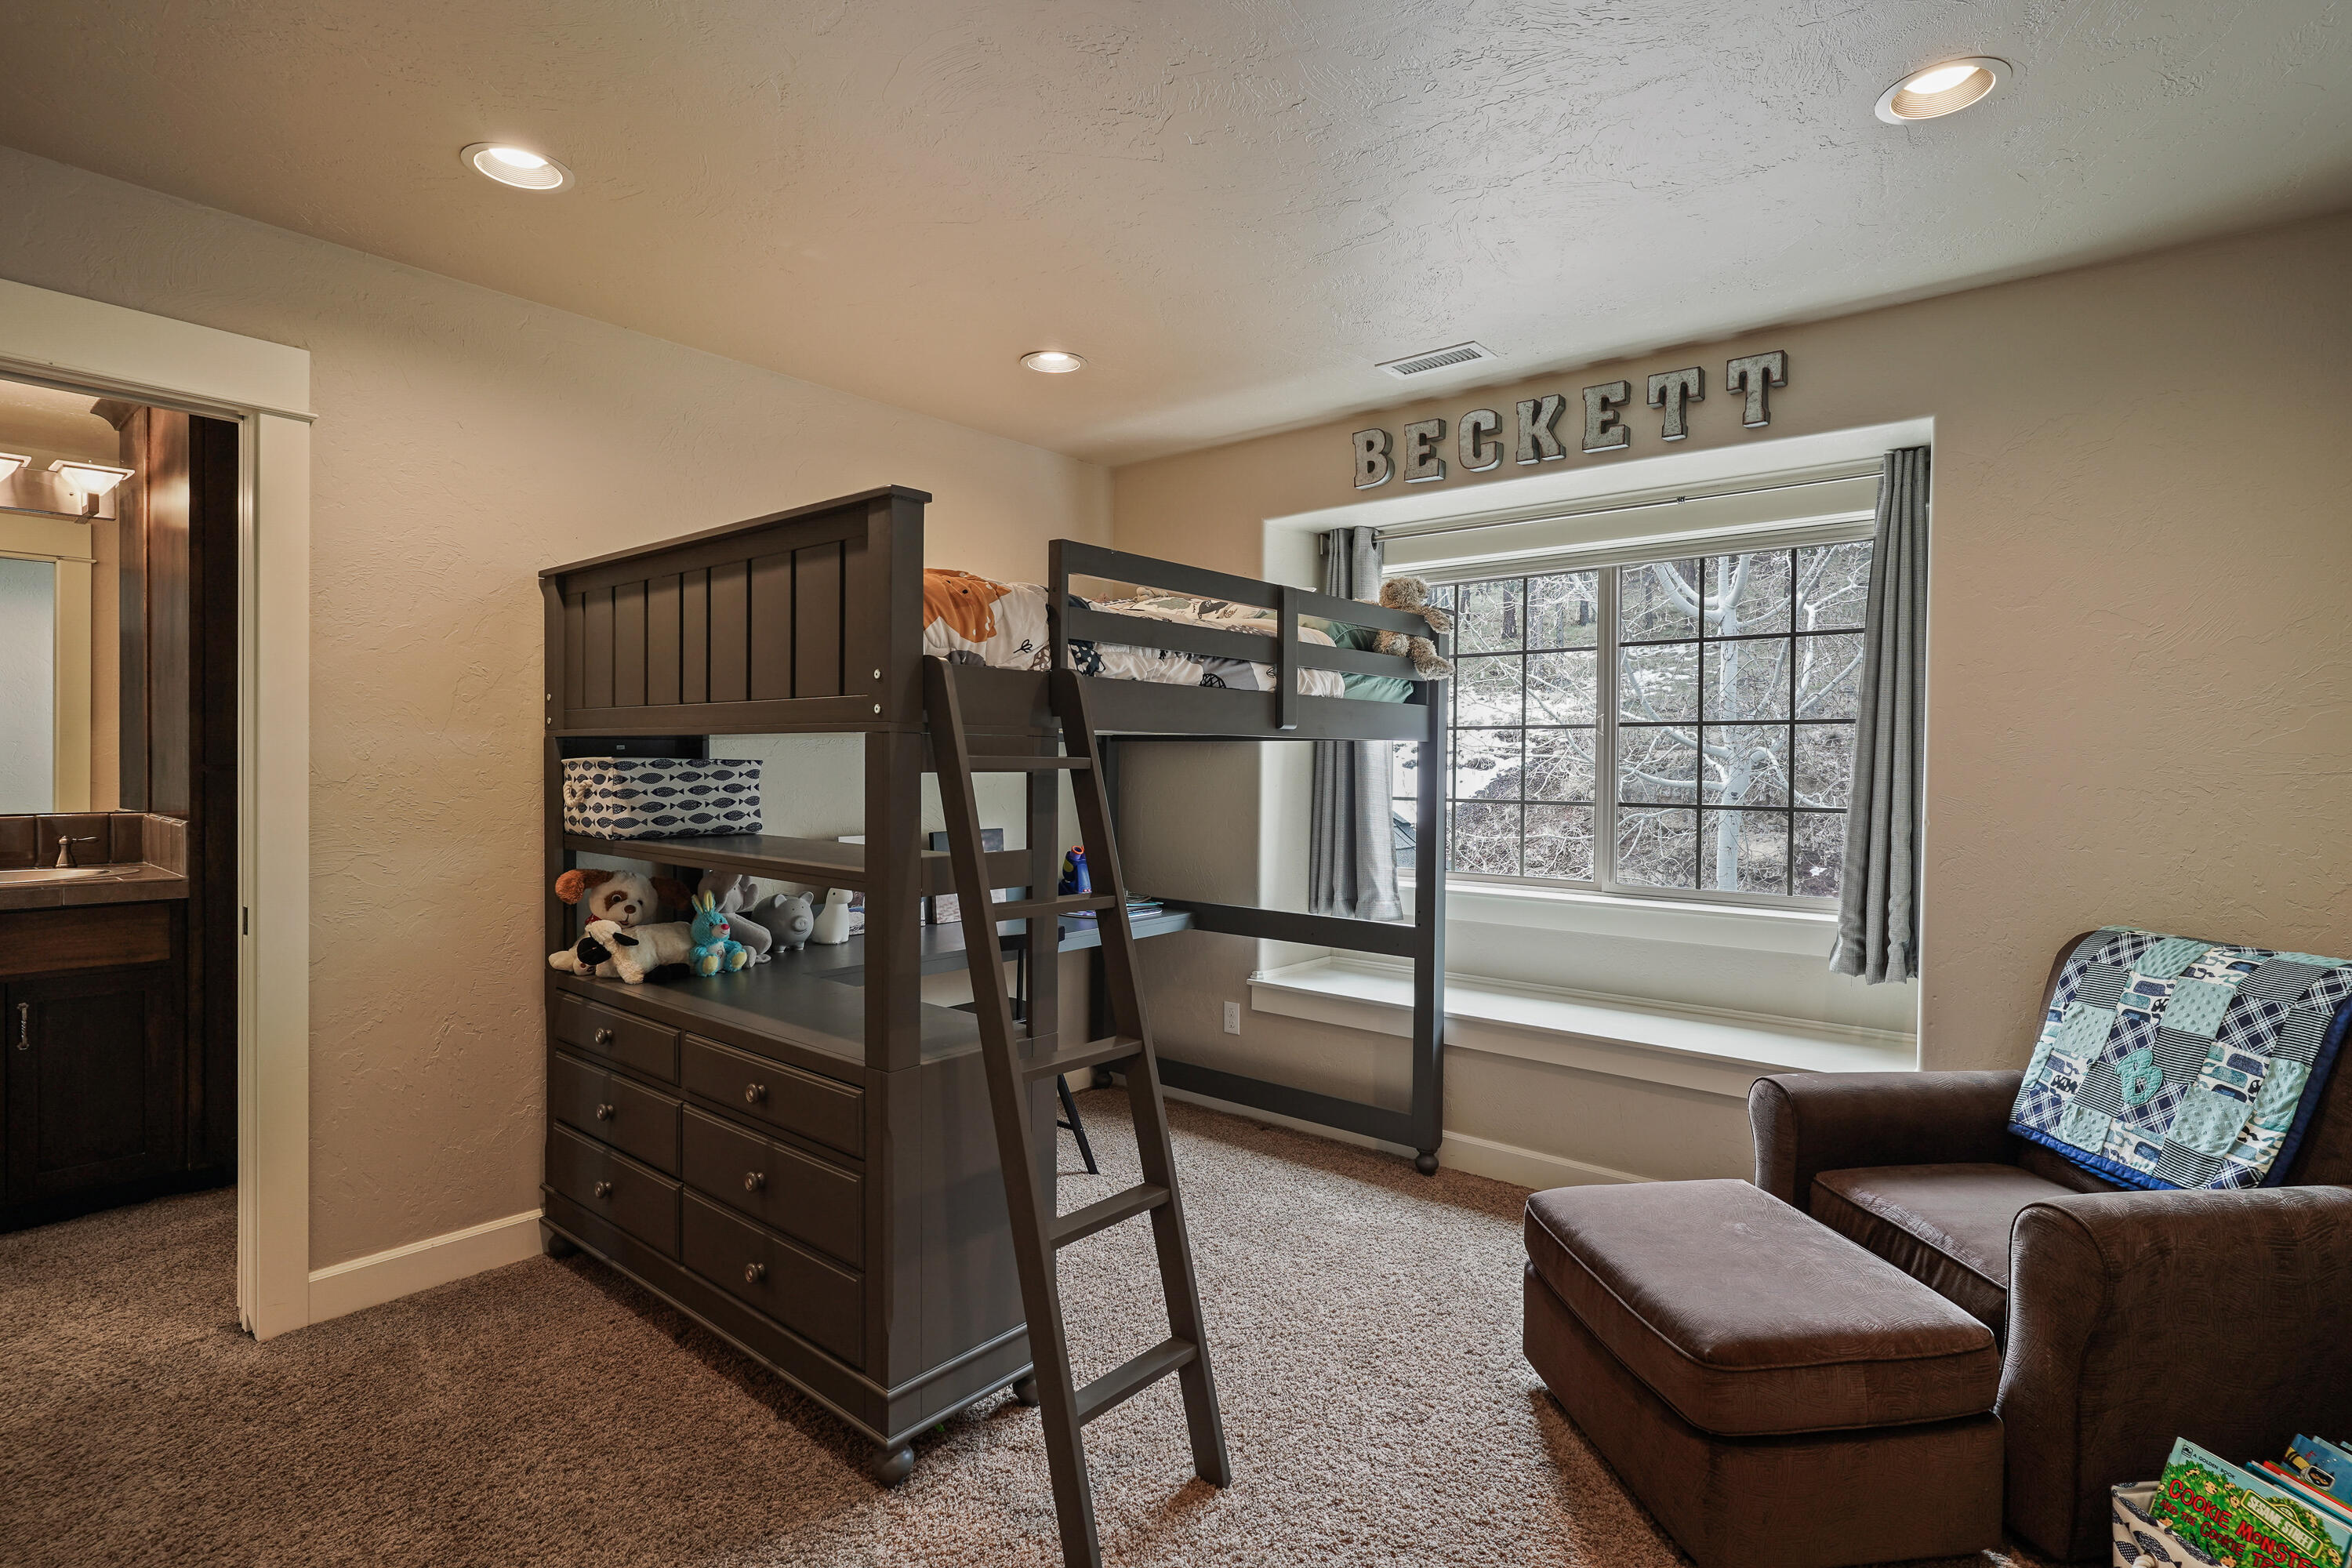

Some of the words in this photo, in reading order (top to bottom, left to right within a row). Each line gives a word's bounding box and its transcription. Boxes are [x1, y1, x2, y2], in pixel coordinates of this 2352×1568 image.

[1352, 350, 1788, 490] BECKETT
[2114, 1048, 2162, 1106] B
[2198, 1457, 2219, 1470] GOLDEN
[2220, 1468, 2236, 1479] BOOK
[2159, 1498, 2179, 1515] AND
[2180, 1512, 2198, 1526] THE
[2169, 1479, 2232, 1530] COOKIE
[2235, 1520, 2320, 1568] MONSTE
[2247, 1496, 2284, 1529] SESAME
[2281, 1520, 2316, 1551] STREET
